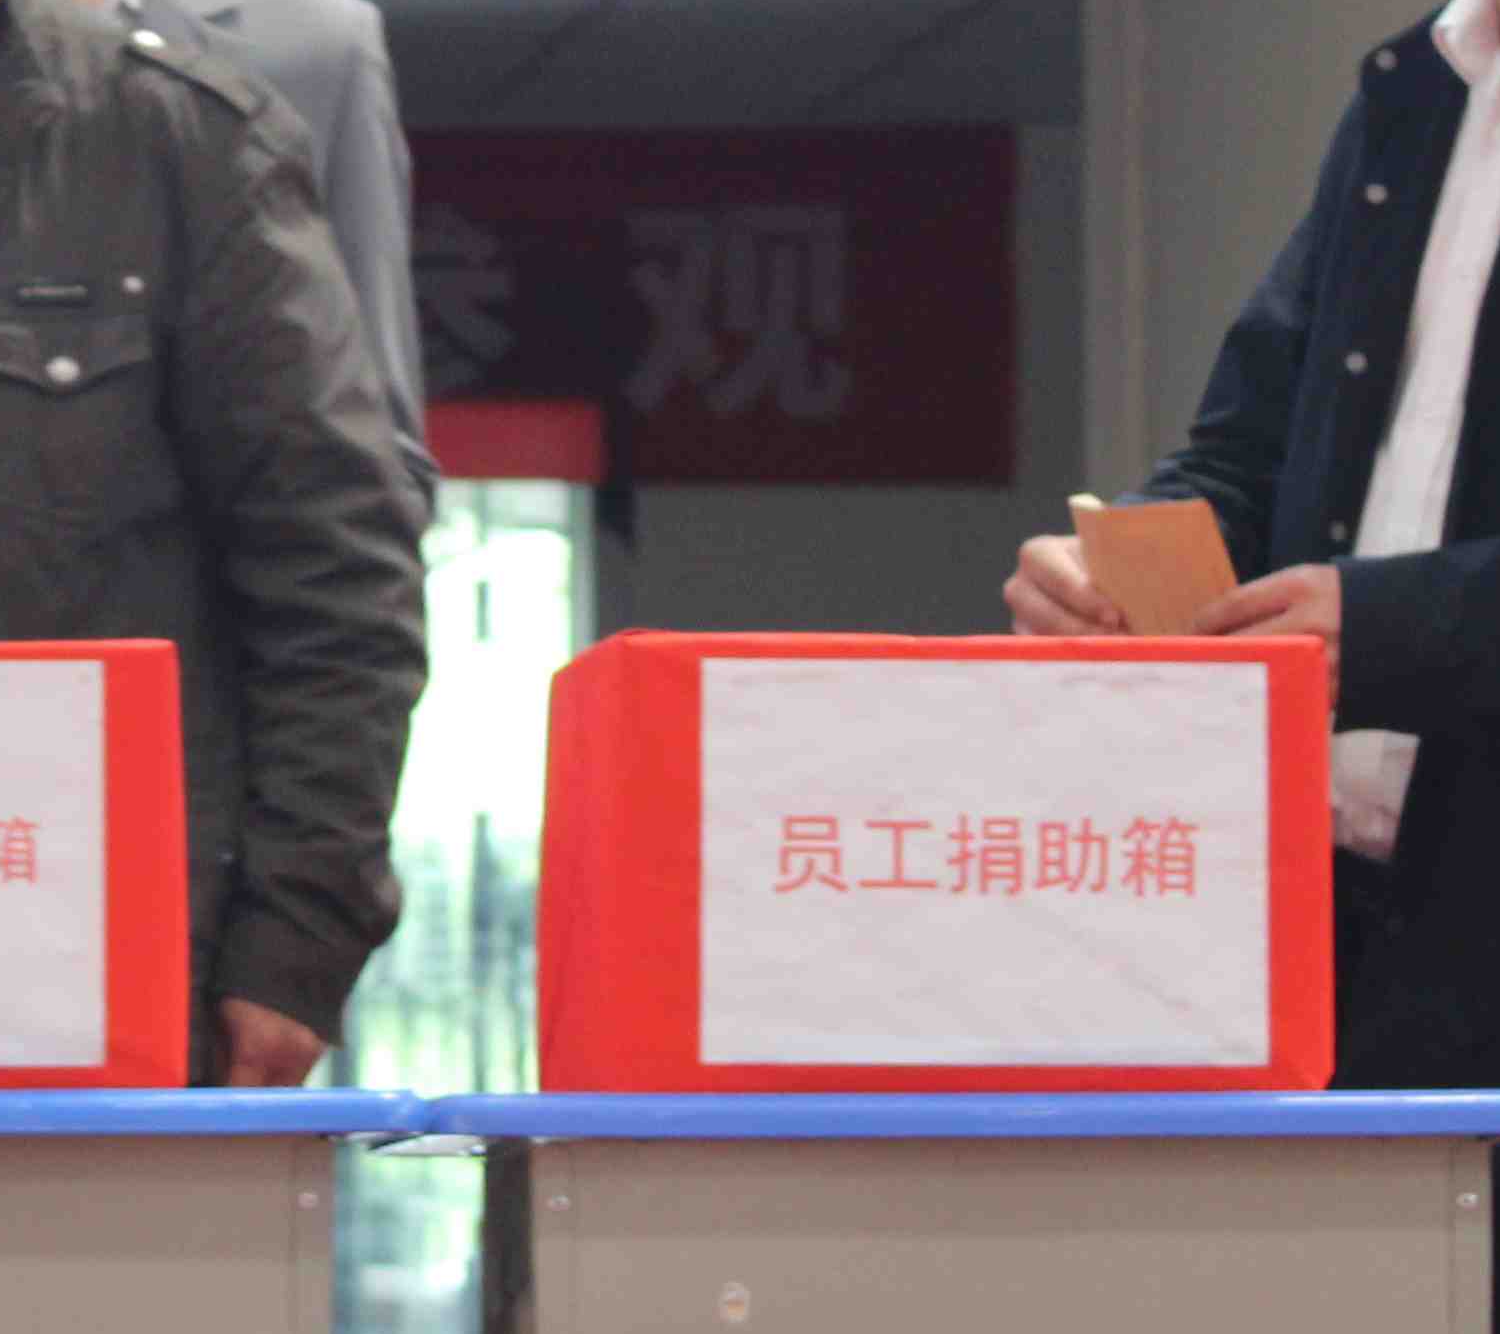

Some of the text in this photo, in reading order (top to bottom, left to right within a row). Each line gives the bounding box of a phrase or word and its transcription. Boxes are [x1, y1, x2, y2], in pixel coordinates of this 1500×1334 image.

[773, 814, 1200, 898] 员工捐助箱
